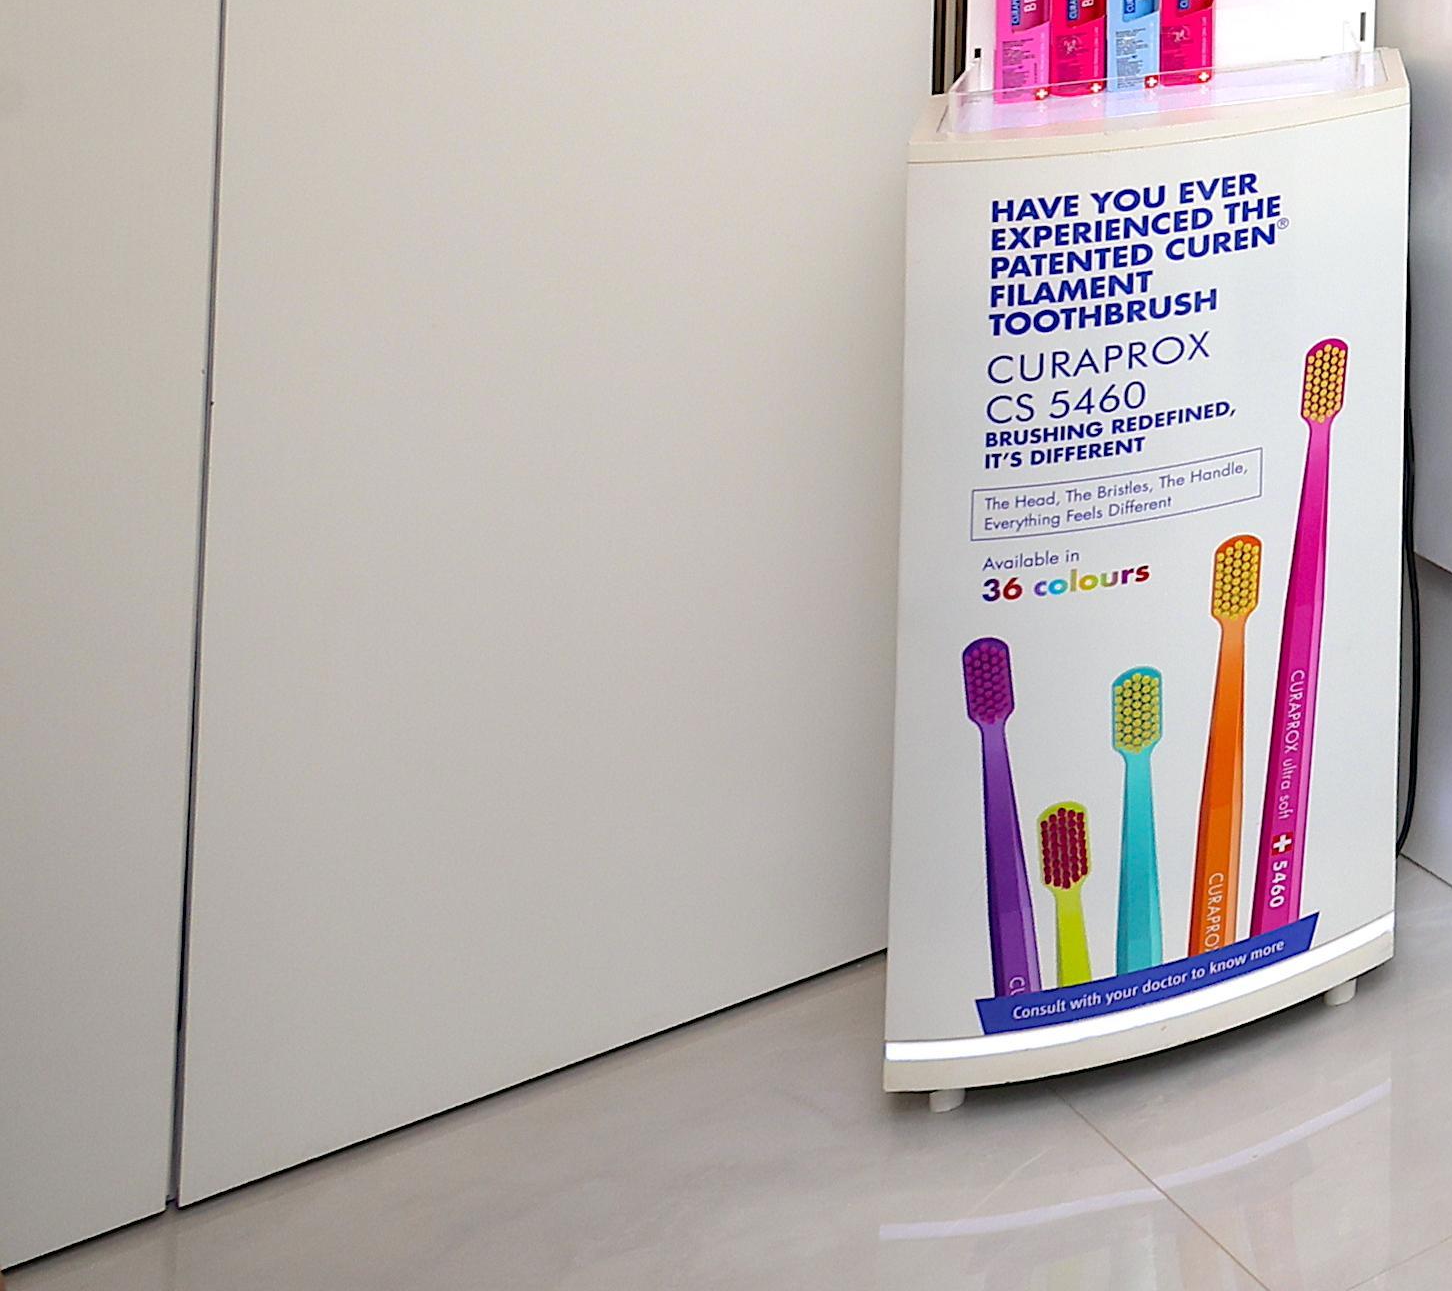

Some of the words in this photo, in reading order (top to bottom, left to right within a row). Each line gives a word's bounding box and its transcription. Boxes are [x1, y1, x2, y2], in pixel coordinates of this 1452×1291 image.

[991, 195, 1080, 223] HAVE
[1090, 185, 1166, 213] YOU
[1179, 172, 1258, 204] EVER
[991, 205, 1213, 251] EXPERIENCED
[1223, 195, 1282, 223] THE
[990, 244, 1154, 279] PATENTED
[989, 270, 1154, 308] FILAMENT
[988, 289, 1218, 336] TOOTHBRUSH
[987, 331, 1210, 385] CURAPROX
[985, 421, 1104, 449] BRUSHING
[1111, 400, 1237, 435] REDEFINED,
[986, 392, 1035, 424] CS
[1048, 380, 1147, 419] 5460
[984, 449, 1023, 469] IT'S
[1030, 436, 1146, 466] DIFFERENT
[985, 495, 1011, 511] The
[1014, 491, 1060, 510] Head,
[1065, 487, 1092, 503] The
[1096, 478, 1154, 501] Bristles,
[1158, 474, 1185, 490] The
[1189, 462, 1249, 487] Handle,
[984, 510, 1061, 535] Everything
[1065, 504, 1103, 522] Feels
[1107, 495, 1173, 517] Different
[982, 552, 1060, 572] Available
[1065, 549, 1080, 564] in
[982, 577, 1023, 602] 36
[1033, 562, 1151, 597] colours
[1284, 670, 1306, 753] CURAPROX
[1280, 759, 1298, 790] ultra
[1278, 794, 1294, 820] soft
[1269, 861, 1289, 908] 5460
[1012, 1000, 1067, 1019] Consult
[1070, 993, 1102, 1010] with
[1106, 987, 1138, 1006] your
[1142, 974, 1187, 993] doctor
[1191, 968, 1206, 979] to
[1209, 956, 1247, 975] know
[1251, 940, 1286, 960] more
